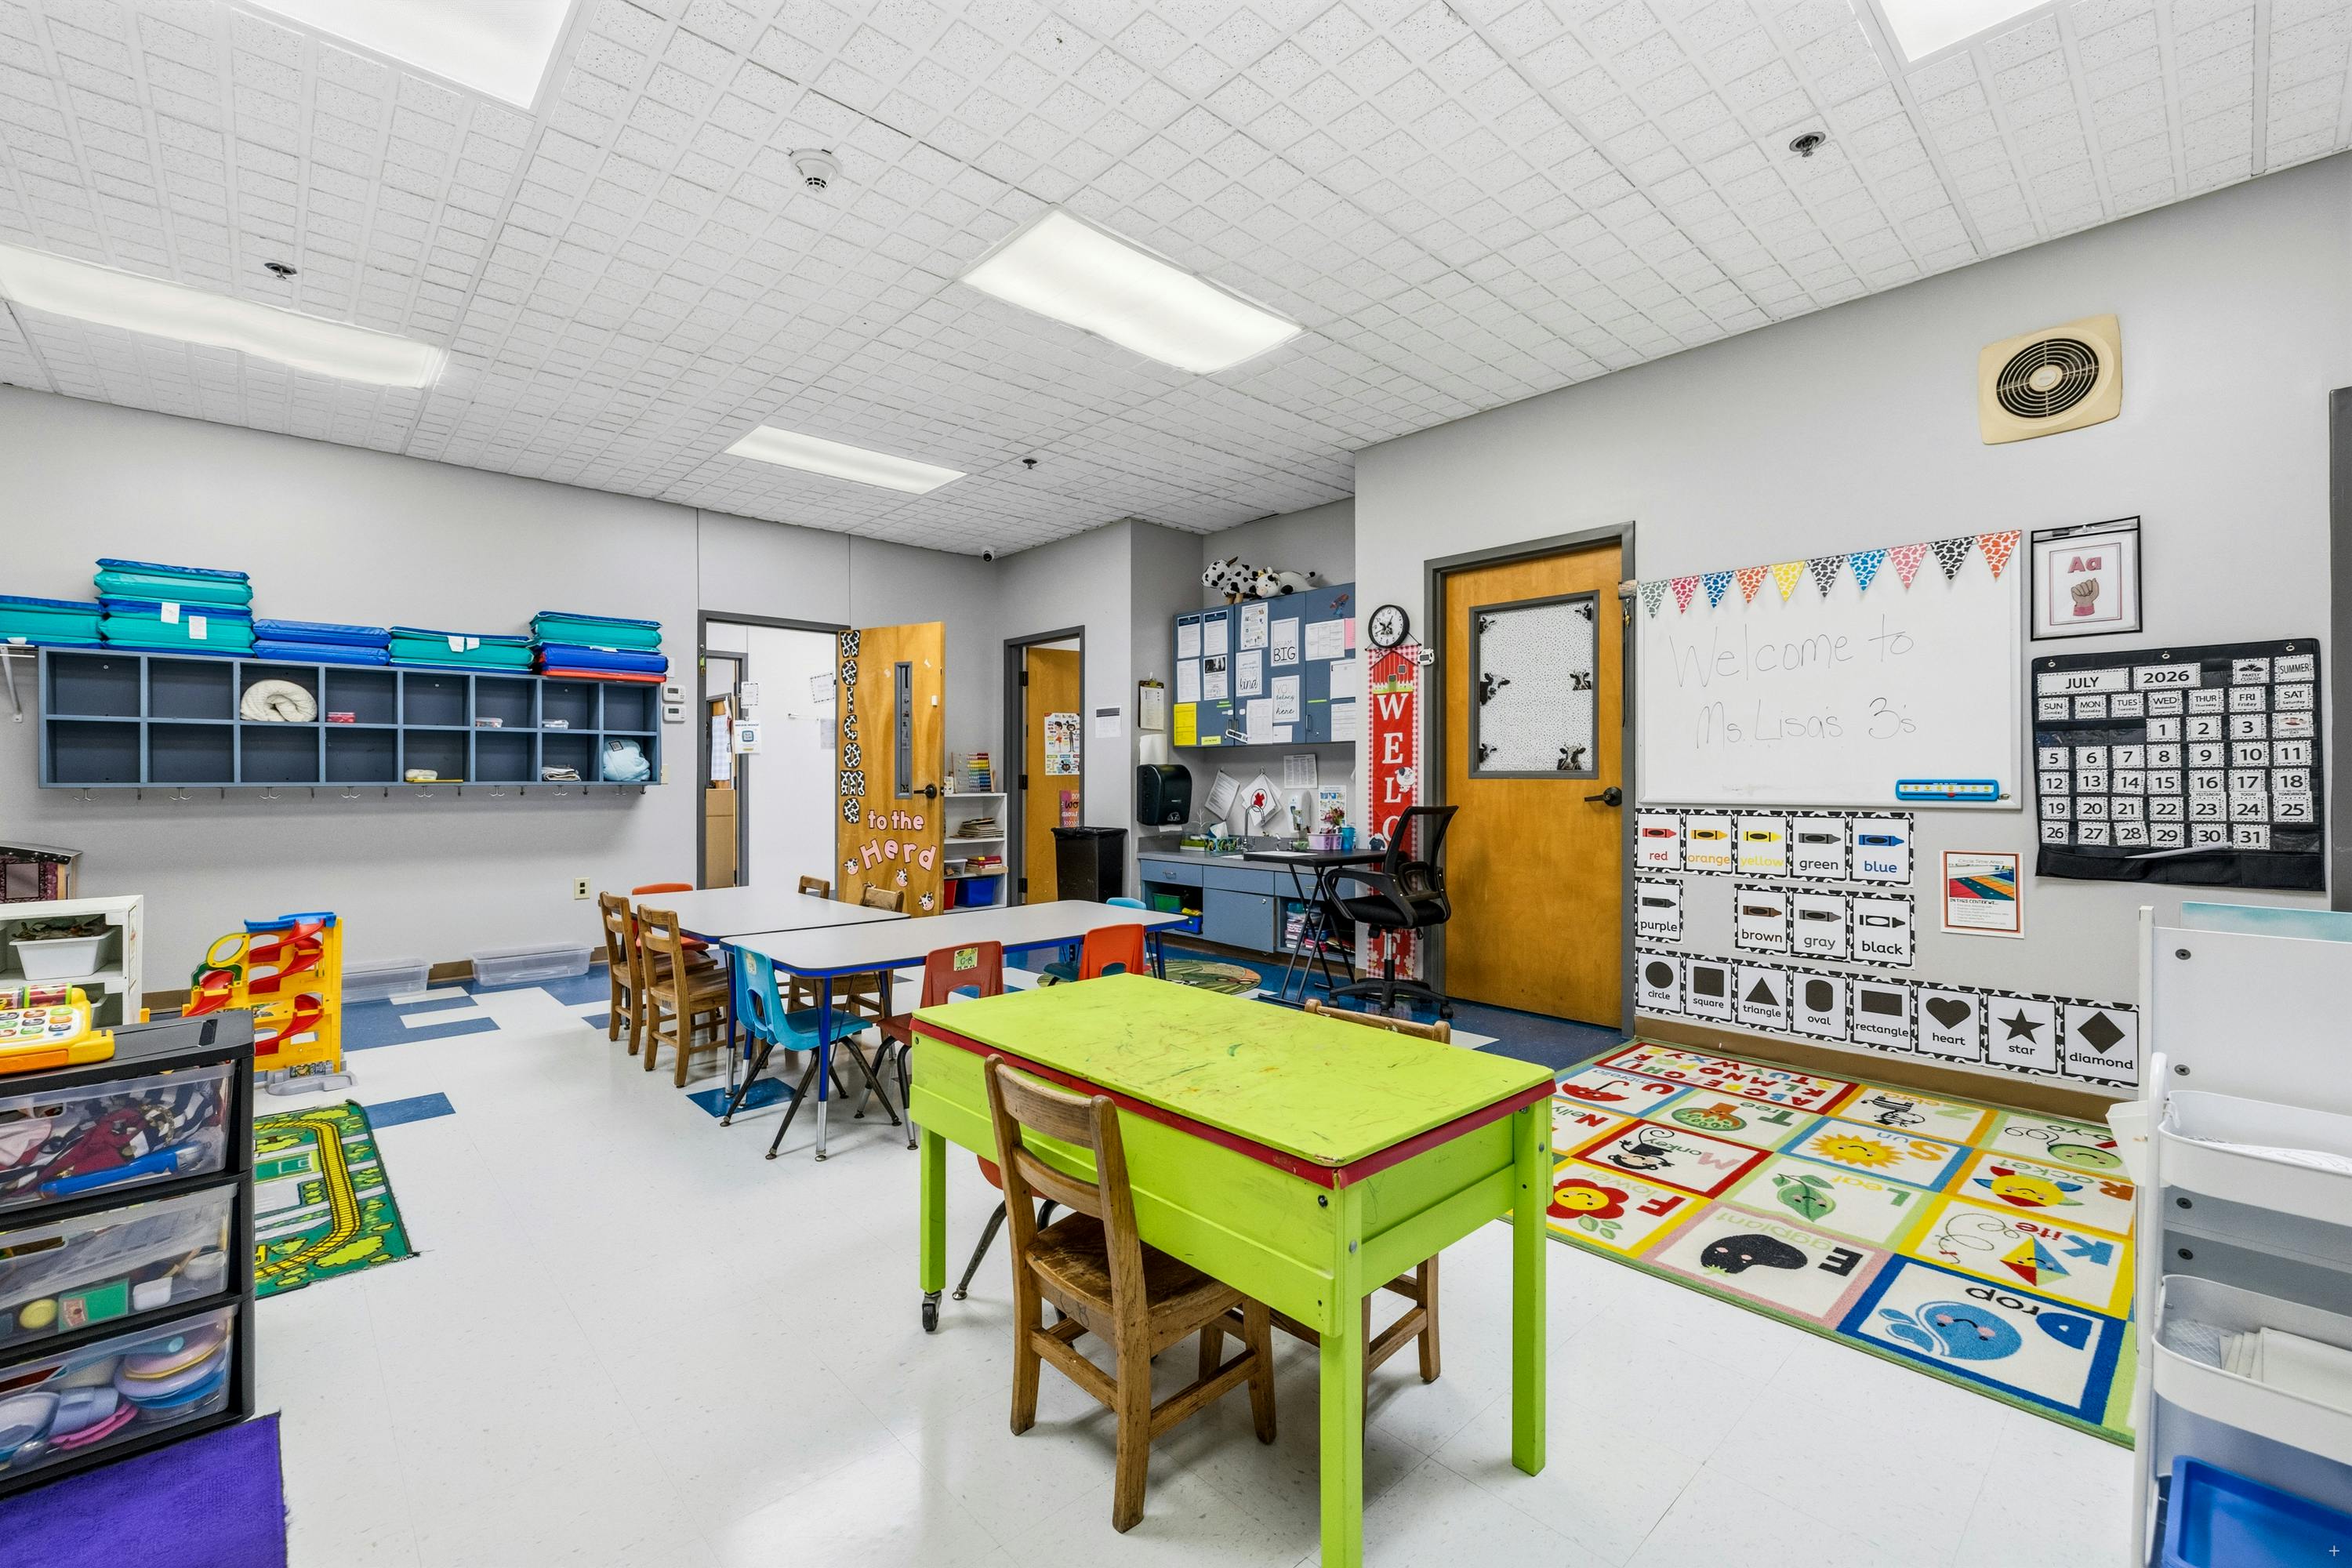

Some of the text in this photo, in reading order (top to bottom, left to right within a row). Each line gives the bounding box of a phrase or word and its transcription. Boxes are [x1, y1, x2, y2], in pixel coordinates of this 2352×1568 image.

[2067, 556, 2102, 573] Aa
[1273, 646, 1296, 662] BIG
[1669, 614, 1914, 688] Welcome to
[2280, 662, 2310, 674] SUMMER
[1239, 678, 1258, 691] kind
[2065, 677, 2100, 689] JULY
[2143, 670, 2190, 684] 2026
[2239, 693, 2256, 702] FRI
[2283, 690, 2305, 699] SAT
[1868, 697, 1917, 739] 3's
[2158, 720, 2253, 736] 1 2 3
[2049, 747, 2301, 764] 5 6 7 8 9 10 11
[2046, 775, 2303, 789] 12 13 14 15 16 17 18
[2049, 802, 2305, 816] 19 20 21 22 23 24 25
[867, 809, 924, 830] to the
[2046, 827, 2260, 844] 26 27 28 29 30 31
[859, 837, 937, 870] Herd
[1650, 851, 1668, 861] red
[1687, 855, 1731, 866] orange
[1740, 855, 1784, 869] yellow
[1799, 859, 1838, 871] green
[1864, 860, 1898, 873] blue
[1639, 920, 1678, 933] purple
[1741, 928, 1783, 943] brown
[1803, 936, 1836, 950] gray
[1861, 940, 1904, 955] black
[1647, 989, 1671, 1000] circle
[1693, 996, 1724, 1010] square
[1742, 1004, 1781, 1018] triangle
[1806, 1014, 1831, 1025] oval
[1855, 1022, 1910, 1038] rectangle
[1932, 1032, 1966, 1046] heart
[2008, 1044, 2036, 1056] star
[2069, 1052, 2134, 1070] diamond
[1592, 1069, 1675, 1095] Umbrella
[1883, 1091, 1980, 1121] Zebra
[1740, 1102, 1795, 1127] Tree
[1877, 1131, 1949, 1161] Sun
[1644, 1138, 1743, 1171] Monkey
[1997, 1158, 2134, 1201] Rocket
[1582, 1171, 1687, 1218] Flower
[1830, 1174, 1912, 1207] Leaf
[1715, 1212, 1864, 1277] Eggplant
[2016, 1221, 2114, 1266] Kite
[1965, 1287, 2094, 1351] Drop
